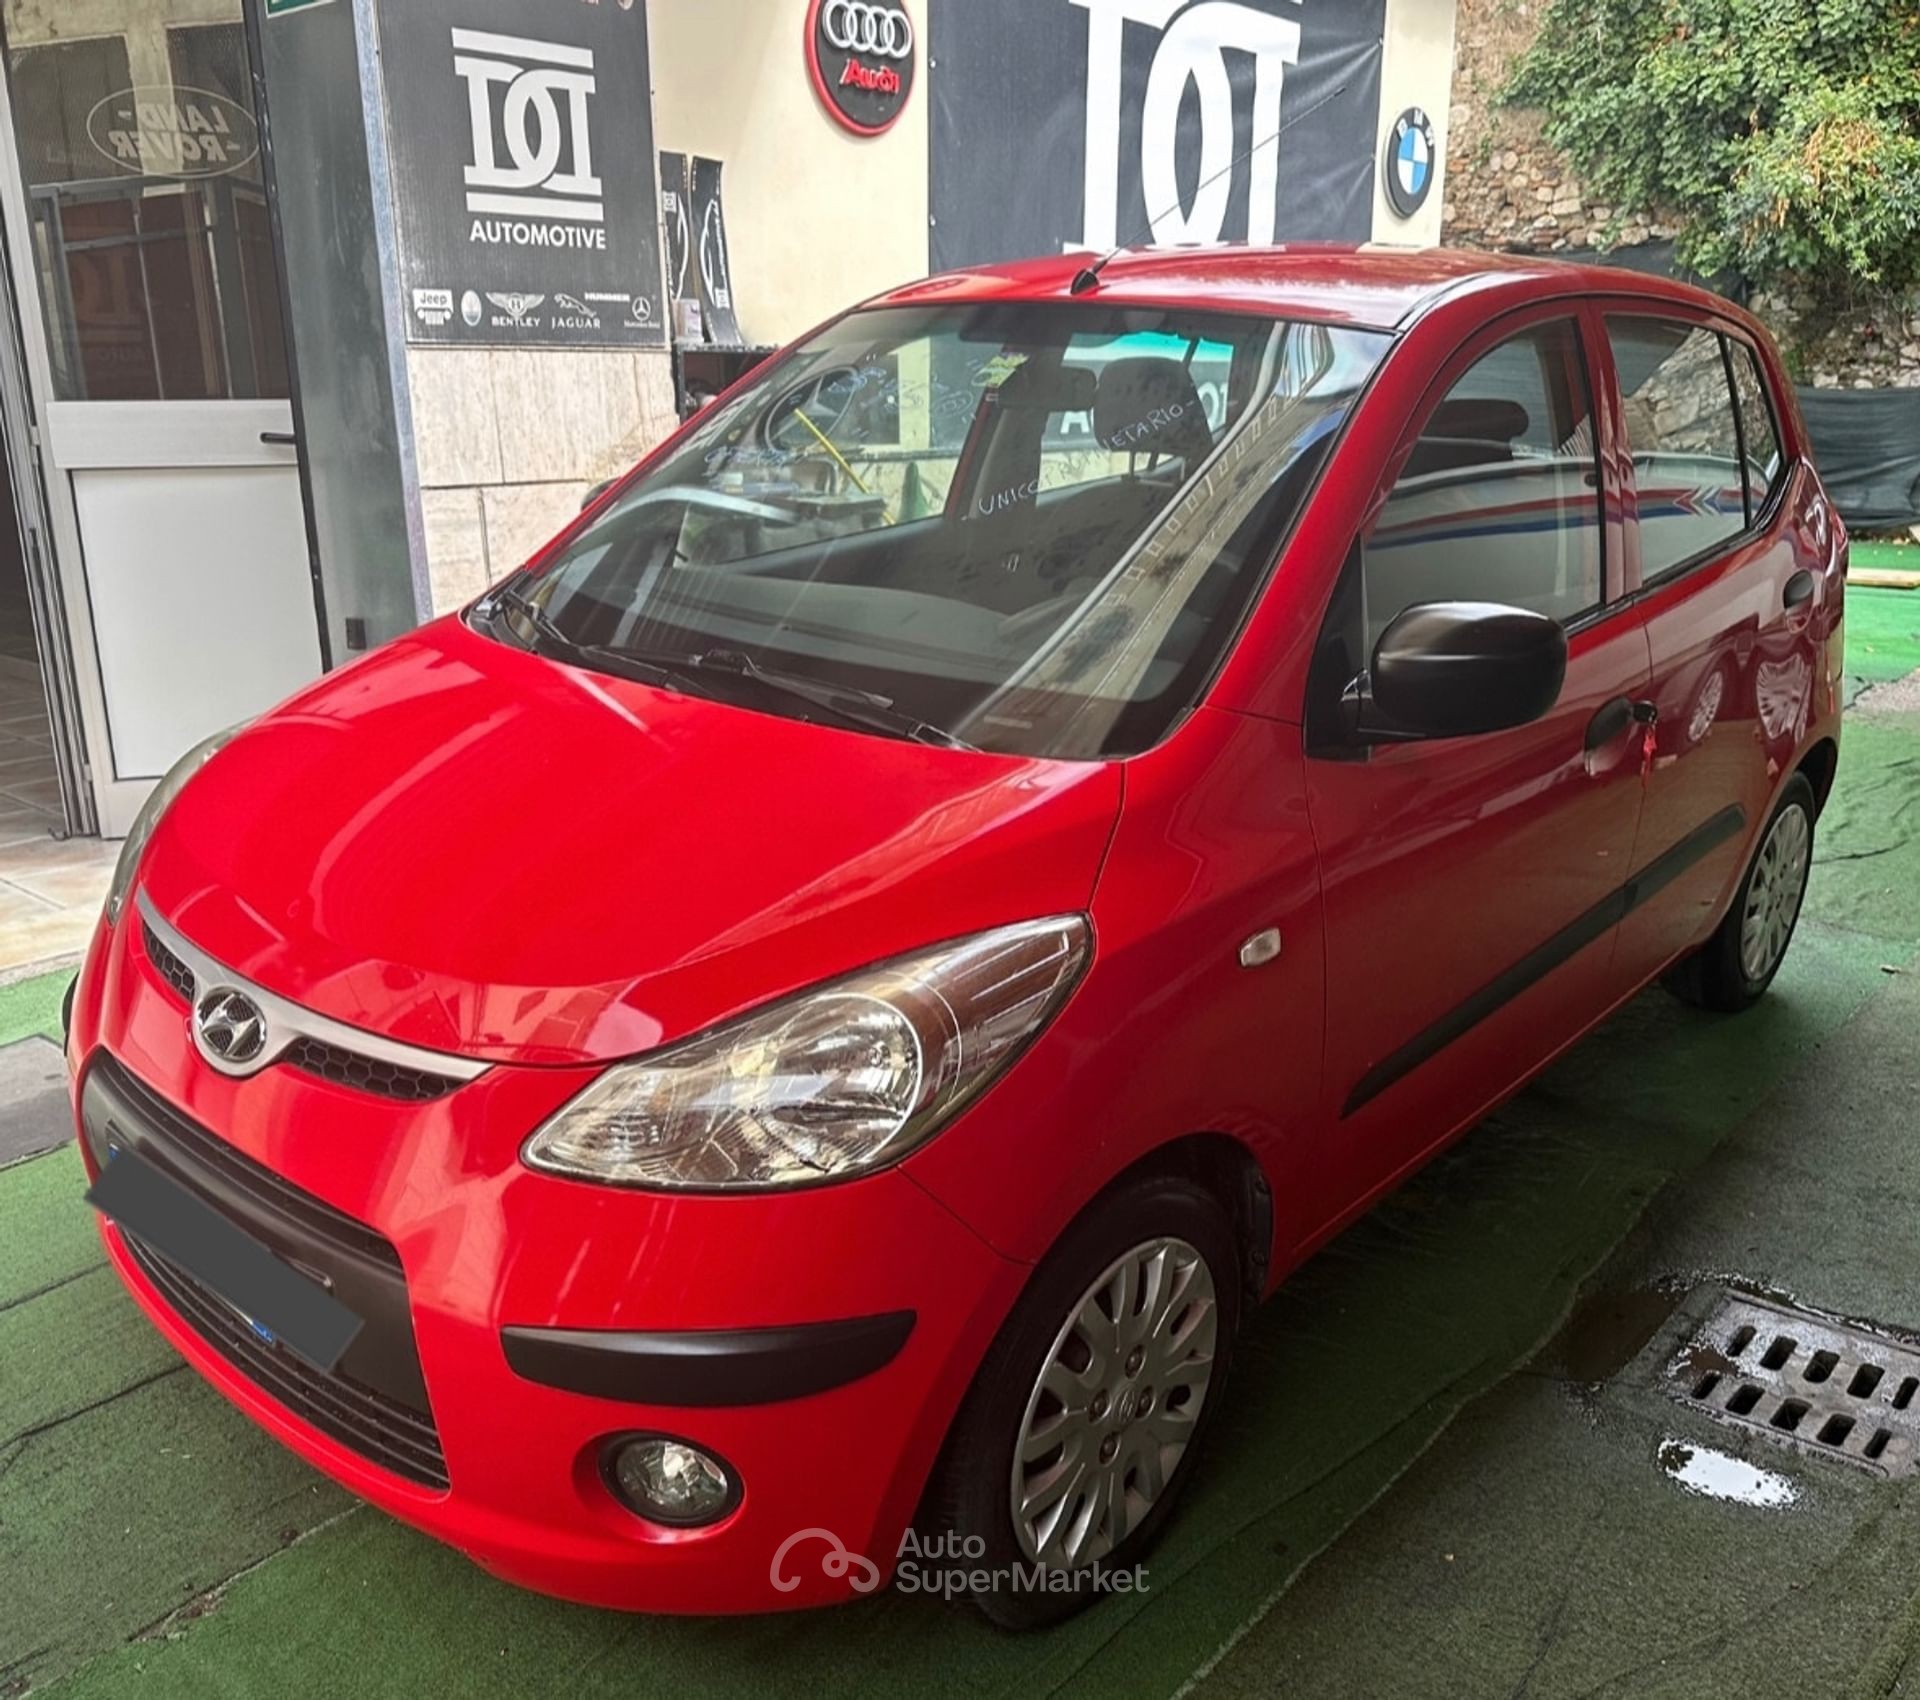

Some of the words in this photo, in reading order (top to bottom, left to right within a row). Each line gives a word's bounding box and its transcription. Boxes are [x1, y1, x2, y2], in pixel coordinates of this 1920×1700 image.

[840, 58, 900, 94] Audi
[470, 219, 606, 249] AUTOMOTIVE
[419, 292, 447, 305] Jeep
[491, 316, 541, 328] BENTLEY
[551, 316, 600, 329] JAGUAR
